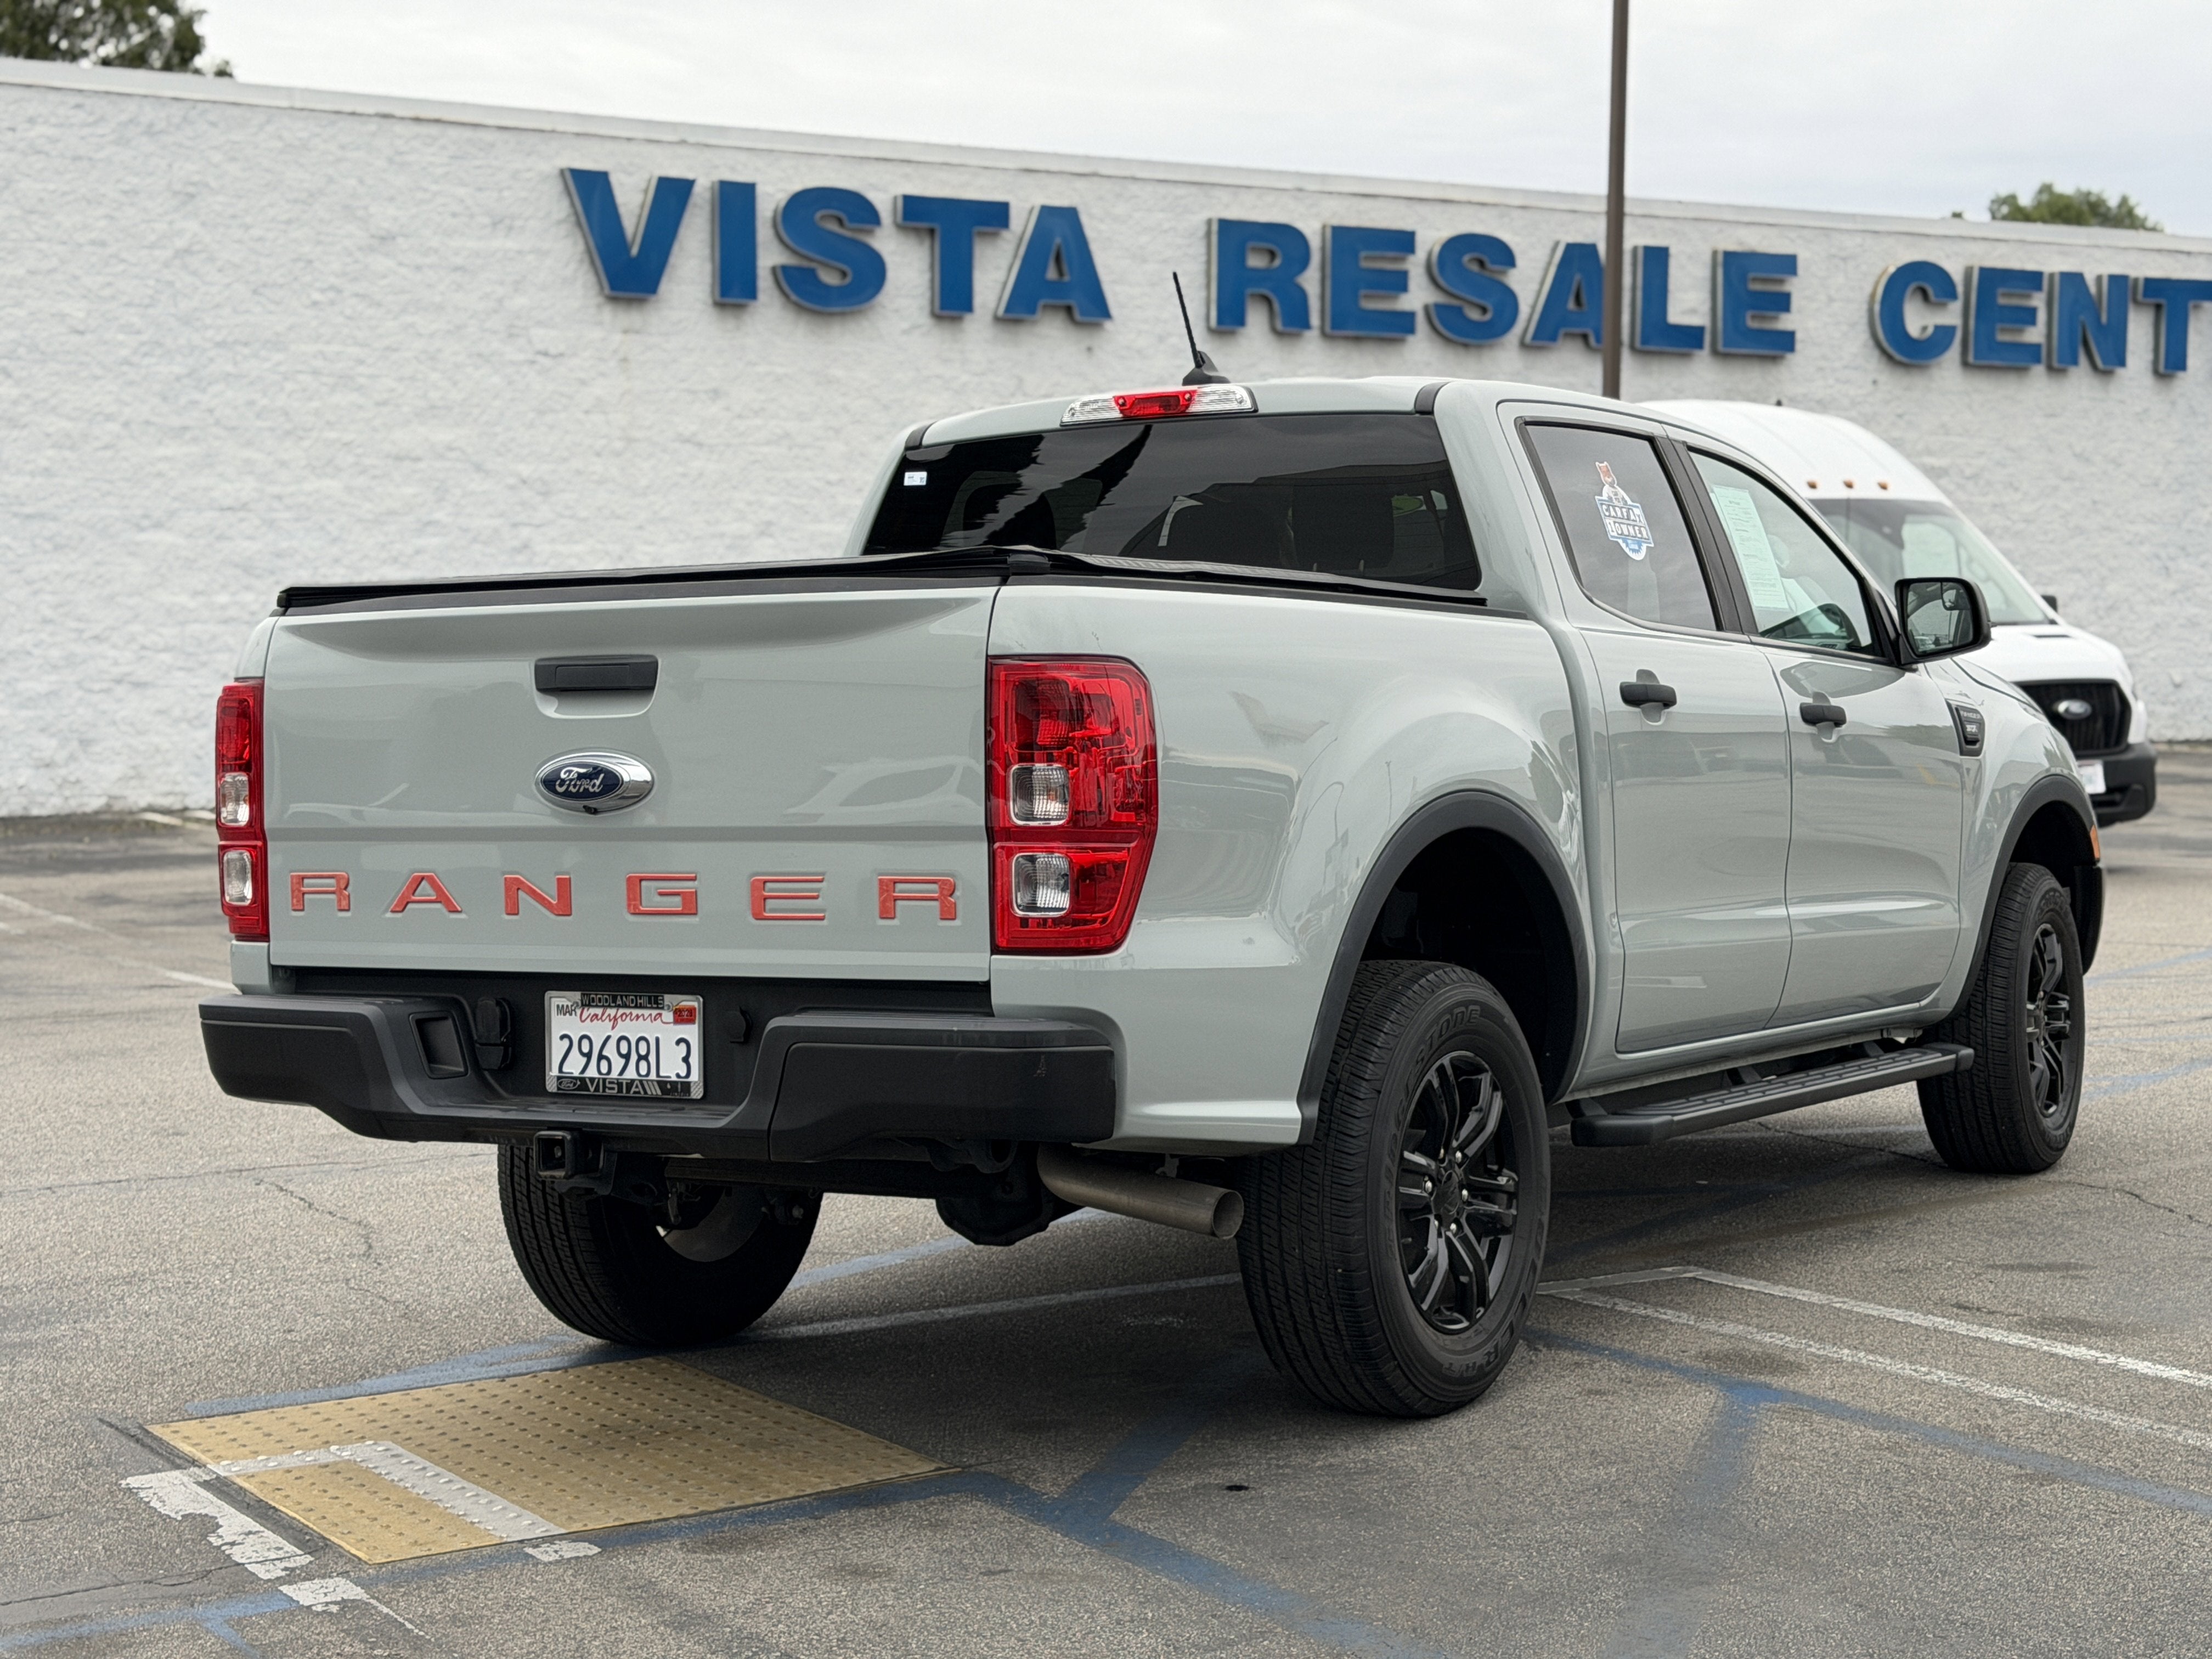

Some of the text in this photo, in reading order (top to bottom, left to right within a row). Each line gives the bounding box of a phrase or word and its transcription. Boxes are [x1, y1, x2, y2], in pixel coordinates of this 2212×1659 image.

[562, 167, 1113, 323] VISTA
[1208, 218, 1798, 356] RESALE
[1601, 504, 1644, 524] CARFAX
[1615, 523, 1649, 539] OWNER
[555, 766, 604, 793] Ford
[290, 871, 957, 922] RANGER
[582, 994, 663, 1008] WOODLAND HILLS
[556, 1004, 673, 1031] MAR California
[558, 1033, 691, 1079] 29698L3
[585, 1077, 645, 1095] VISTA
